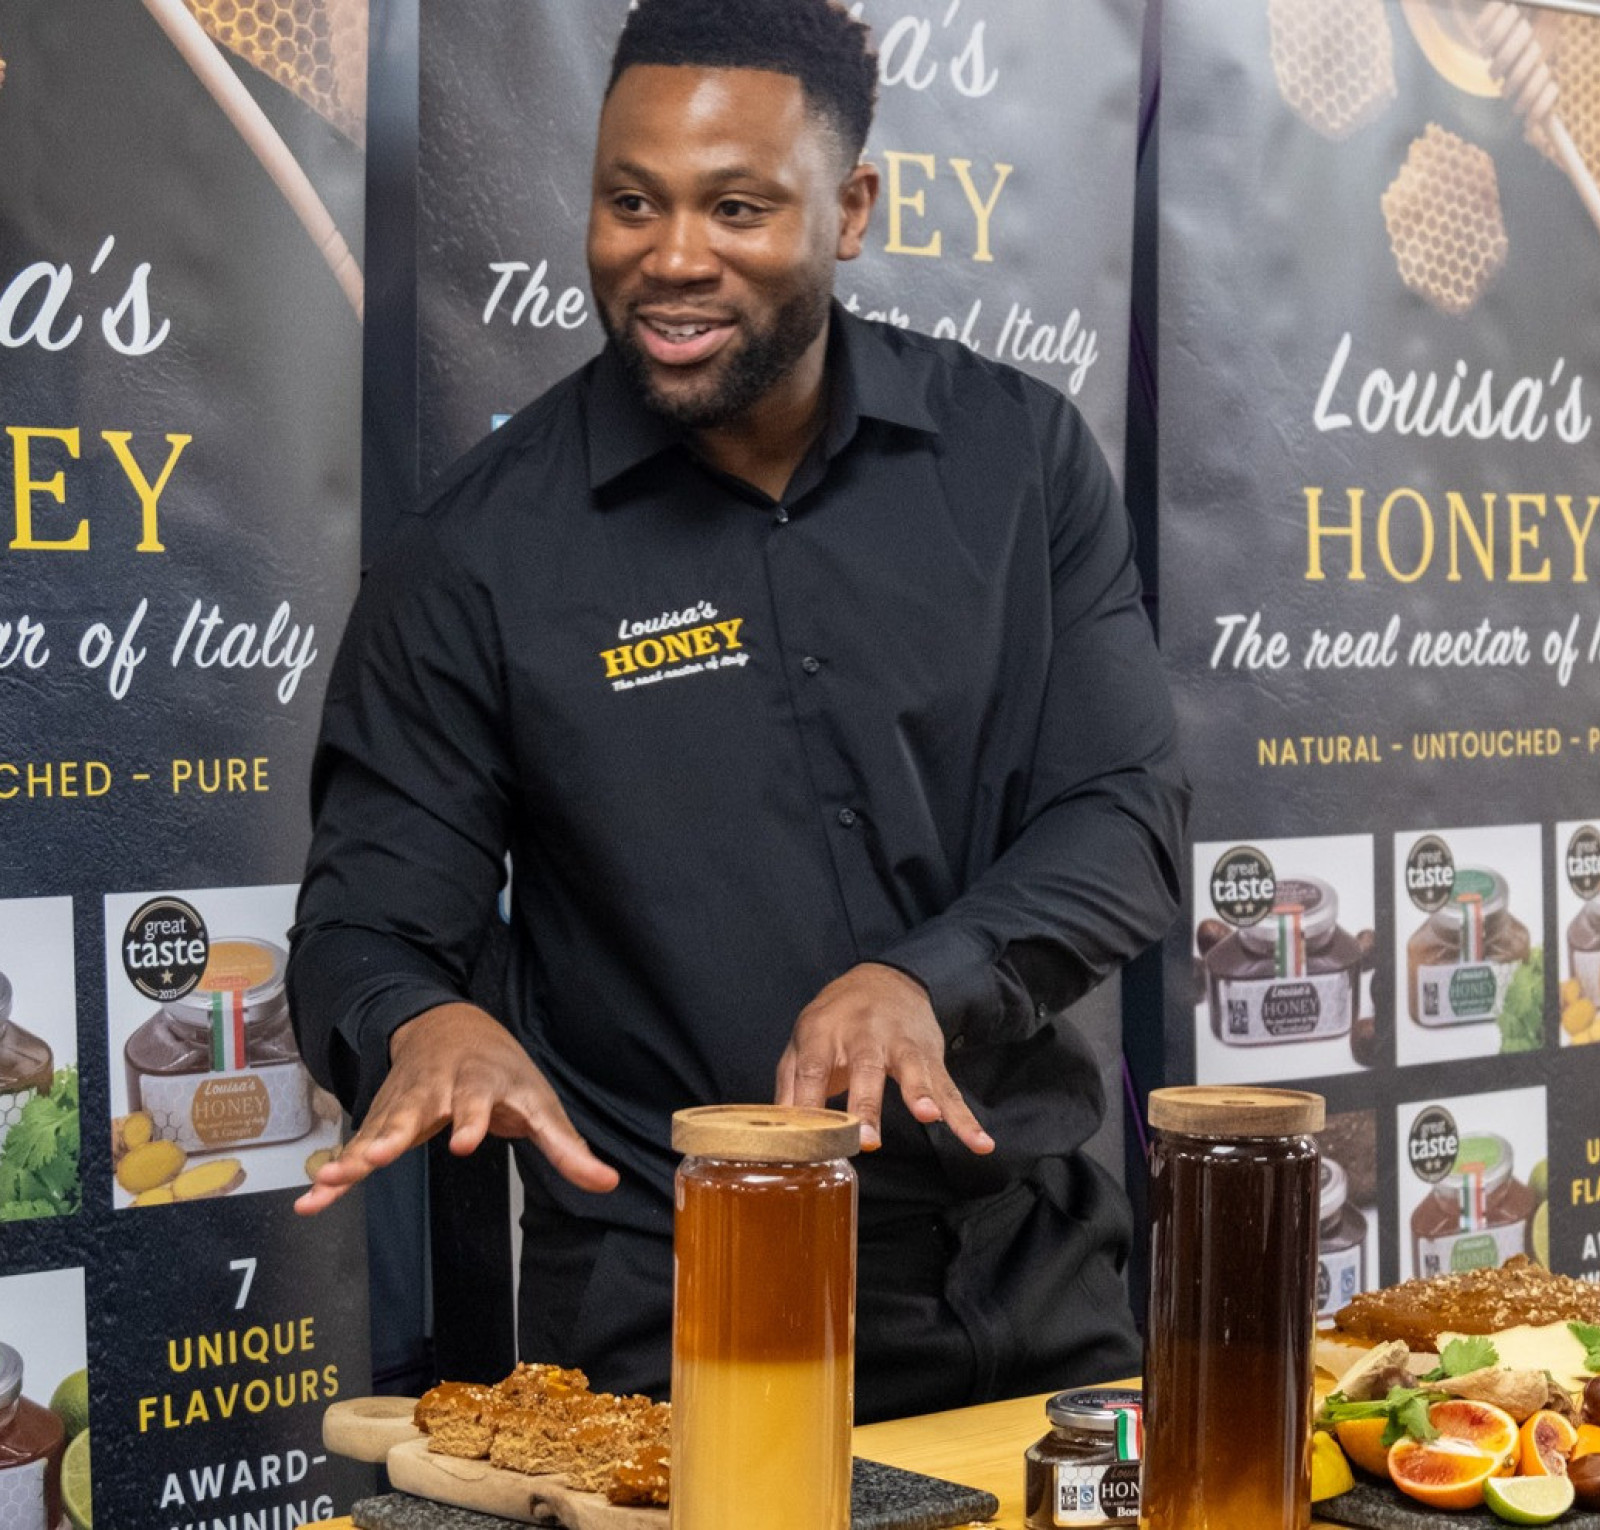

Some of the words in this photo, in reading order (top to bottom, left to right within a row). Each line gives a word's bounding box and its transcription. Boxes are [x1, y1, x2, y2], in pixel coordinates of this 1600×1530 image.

[879, 0, 999, 98] a's
[884, 150, 1013, 262] EY
[482, 259, 588, 329] The
[995, 302, 1098, 396] Italy
[1313, 332, 1592, 444] Louisa's
[1303, 486, 1600, 584] HONEY
[618, 600, 718, 640] Louisa's
[79, 598, 148, 700] of
[171, 598, 318, 704] Italy
[600, 616, 744, 678] HONEY
[1210, 612, 1290, 670] The
[1303, 614, 1400, 670] real
[1408, 617, 1531, 667] nectar
[1543, 613, 1580, 688] of
[1257, 735, 1382, 766] NATURAL
[1413, 729, 1562, 760] UNTOUCHED
[172, 757, 270, 794] PURE
[1408, 864, 1454, 889] taste
[1568, 854, 1600, 876] tast
[1213, 877, 1274, 902] taste
[145, 916, 187, 940] great
[126, 937, 206, 969] taste
[1263, 999, 1318, 1017] HONEY
[204, 1078, 256, 1096] Louisa's
[195, 1095, 266, 1119] HONEY
[1410, 1135, 1457, 1160] taste
[1571, 1177, 1600, 1205] FL
[229, 1257, 257, 1310] 7
[168, 1317, 315, 1373] UNIQUE
[138, 1364, 339, 1433] FLAVOURS
[160, 1449, 327, 1508] AWARD-
[1102, 1481, 1139, 1499] HON
[1117, 1506, 1139, 1517] Bos
